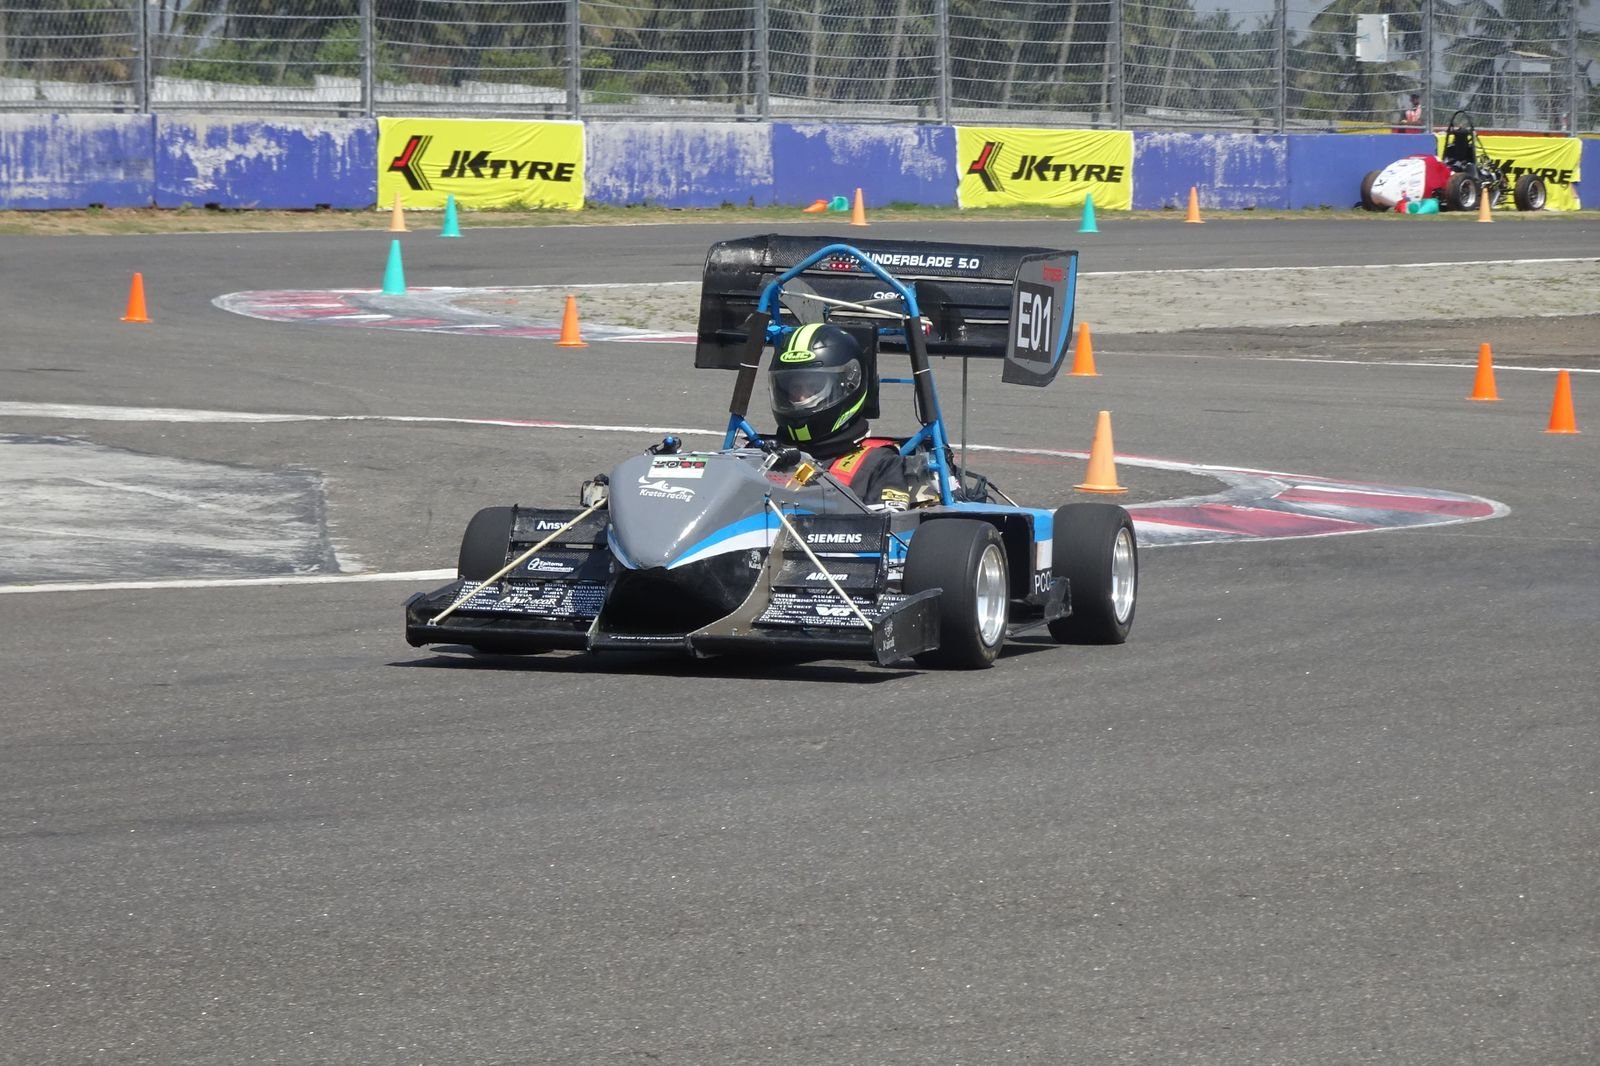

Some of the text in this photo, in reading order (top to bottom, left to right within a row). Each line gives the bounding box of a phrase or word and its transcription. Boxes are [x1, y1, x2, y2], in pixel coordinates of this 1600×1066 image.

[850, 252, 980, 270] UNDERBLADE 5.0
[1017, 291, 1052, 352] E01
[536, 521, 573, 530] Ansy
[806, 533, 862, 544] SIEMENS
[805, 572, 849, 581] Altum
